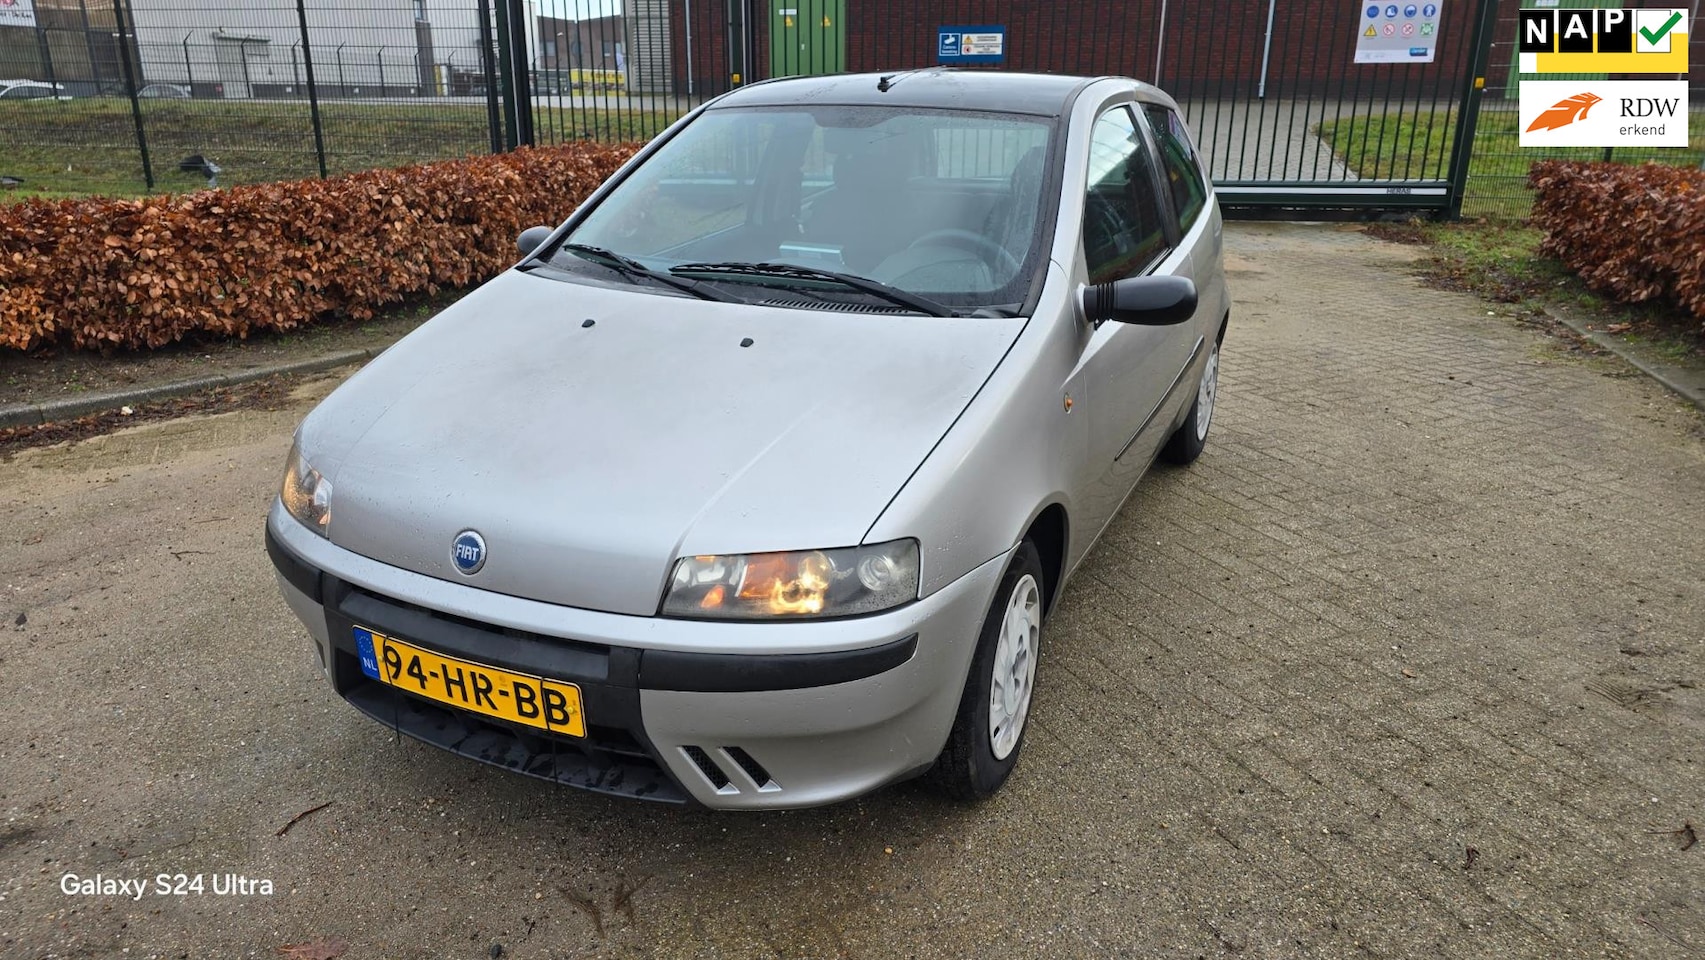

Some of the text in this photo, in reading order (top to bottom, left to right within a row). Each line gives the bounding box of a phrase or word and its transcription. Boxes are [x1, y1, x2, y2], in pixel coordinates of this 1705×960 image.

[456, 543, 479, 562] FIAT
[362, 645, 570, 727] NL 94-HR-BB
